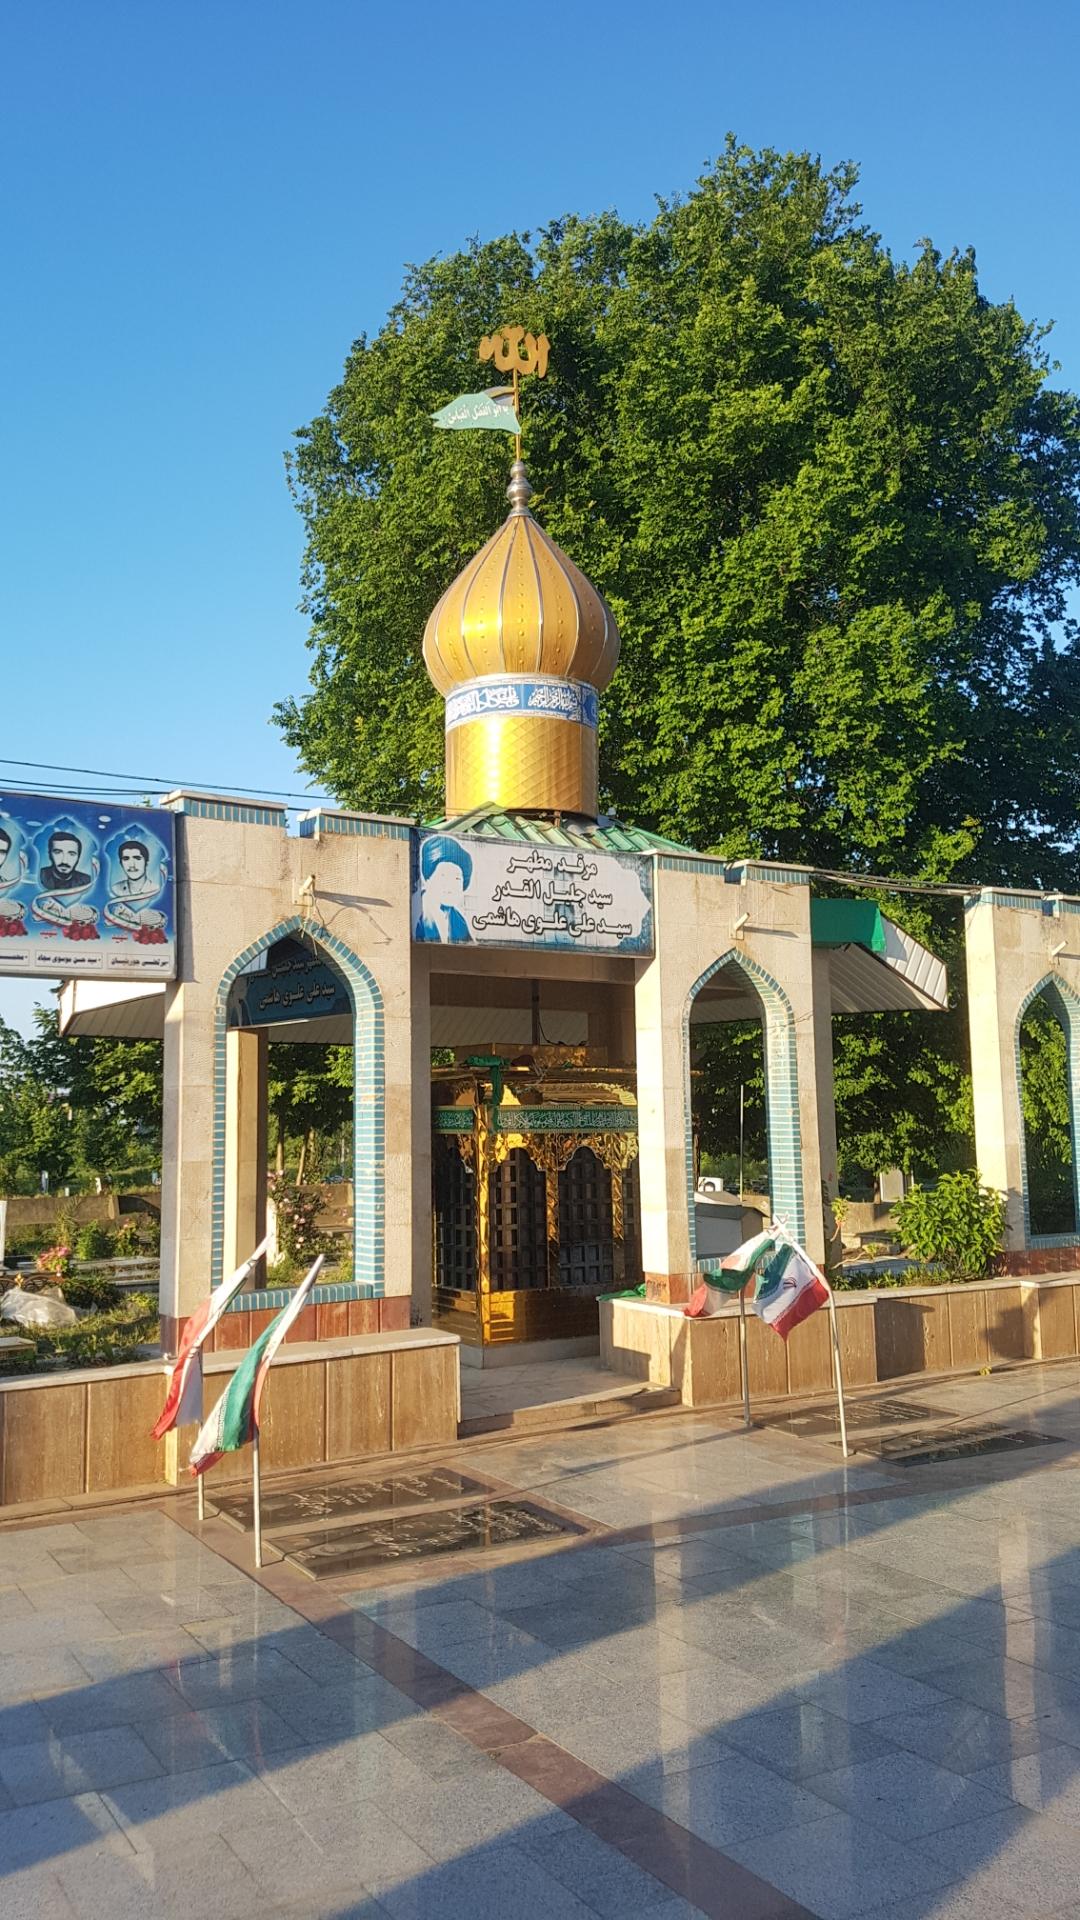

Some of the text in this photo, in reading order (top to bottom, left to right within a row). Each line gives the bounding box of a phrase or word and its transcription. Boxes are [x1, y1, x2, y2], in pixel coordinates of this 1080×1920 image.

[506, 849, 598, 881] مرقد مطهر
[492, 879, 613, 910] سید جلیل القدر
[471, 906, 633, 939] سید علی علوی هاشمی
[282, 982, 305, 1007] علوی
[306, 981, 321, 1003] علی
[321, 982, 336, 1000] سید
